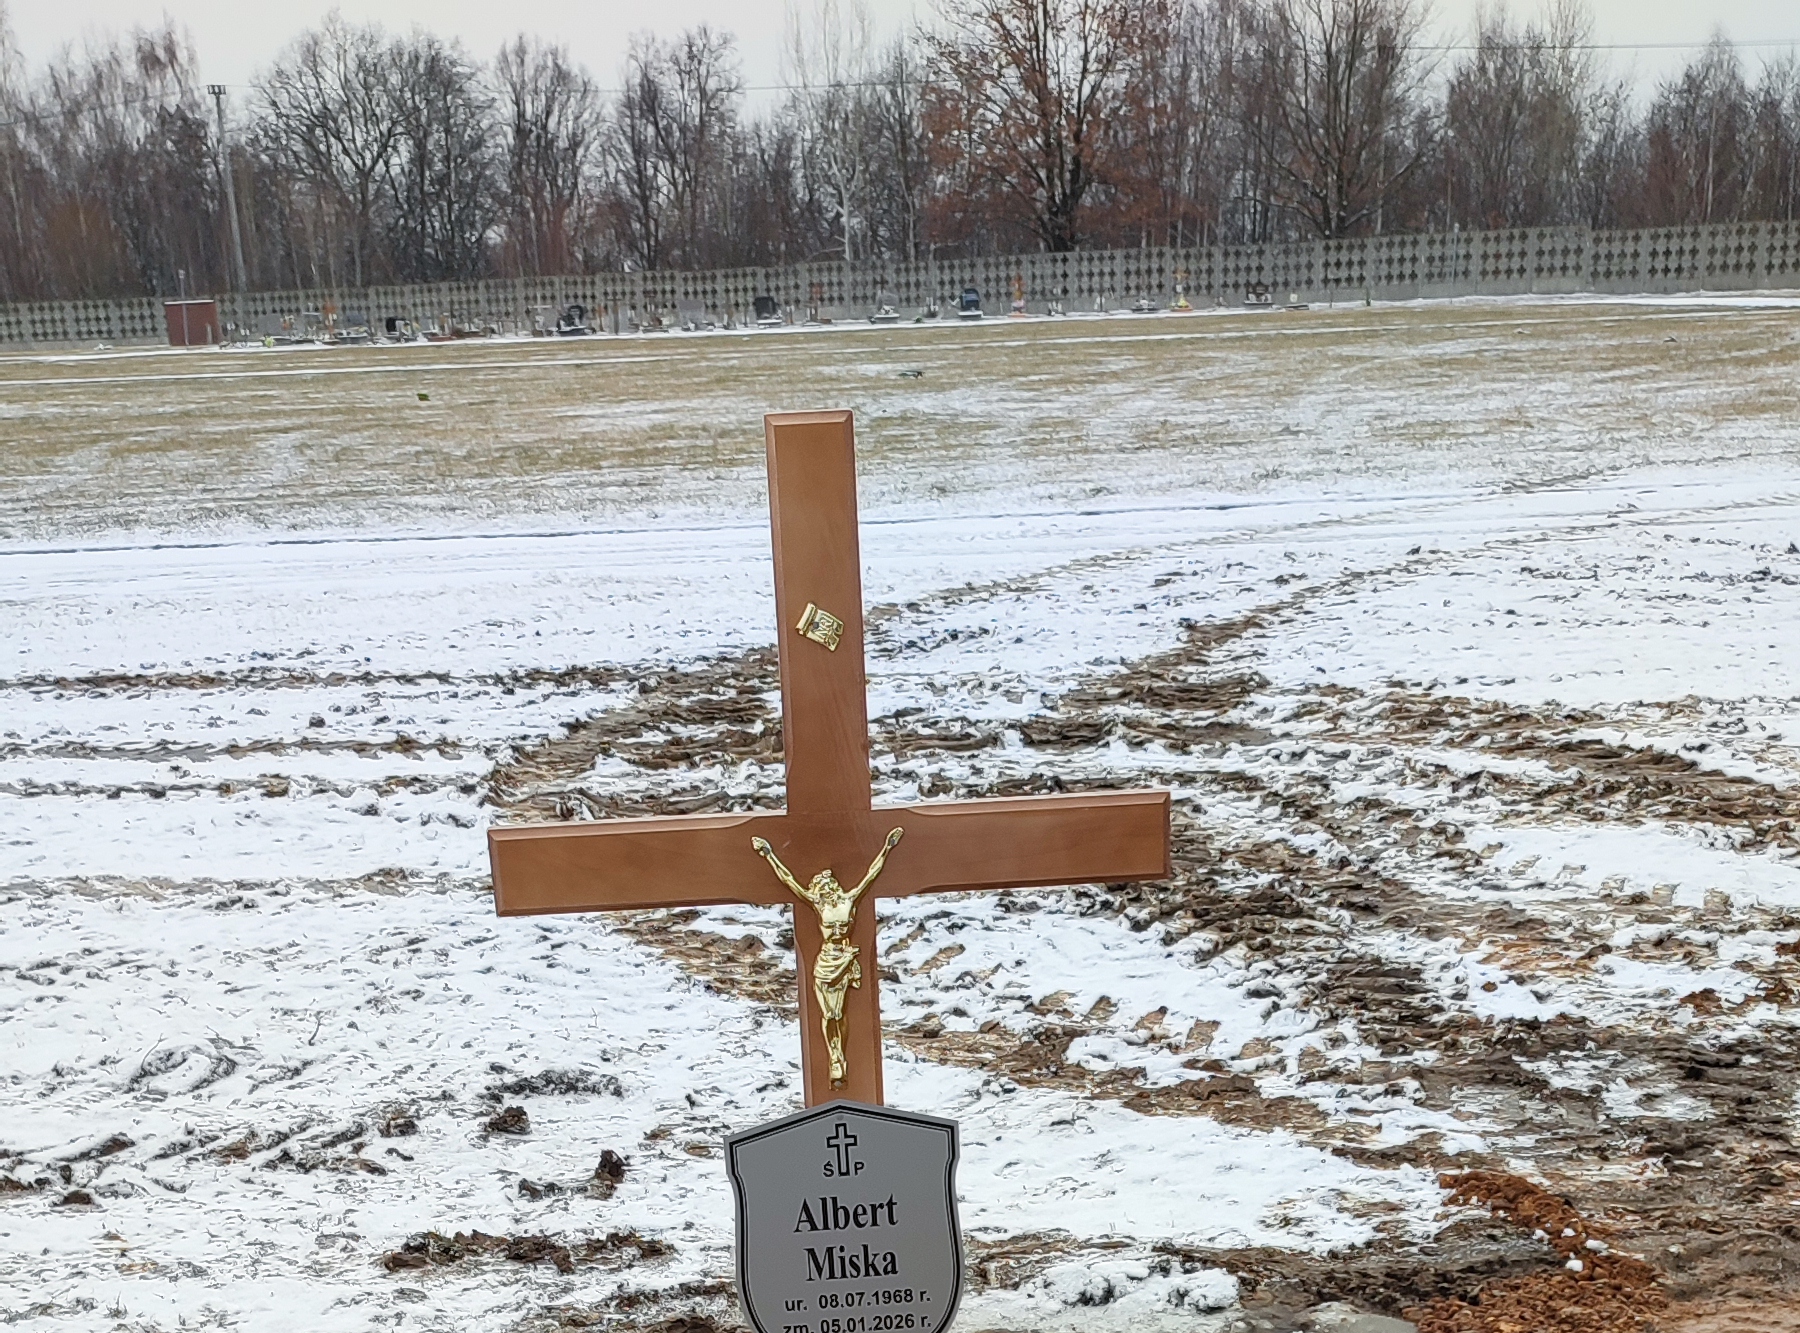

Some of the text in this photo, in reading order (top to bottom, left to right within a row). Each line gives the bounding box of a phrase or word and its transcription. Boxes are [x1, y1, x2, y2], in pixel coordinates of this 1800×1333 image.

[823, 1160, 865, 1178] Ś P
[793, 1193, 899, 1233] Albert
[803, 1244, 899, 1282] Miska
[785, 1288, 931, 1312] ur. 08.07.1968 r.
[920, 1315, 932, 1328] r.
